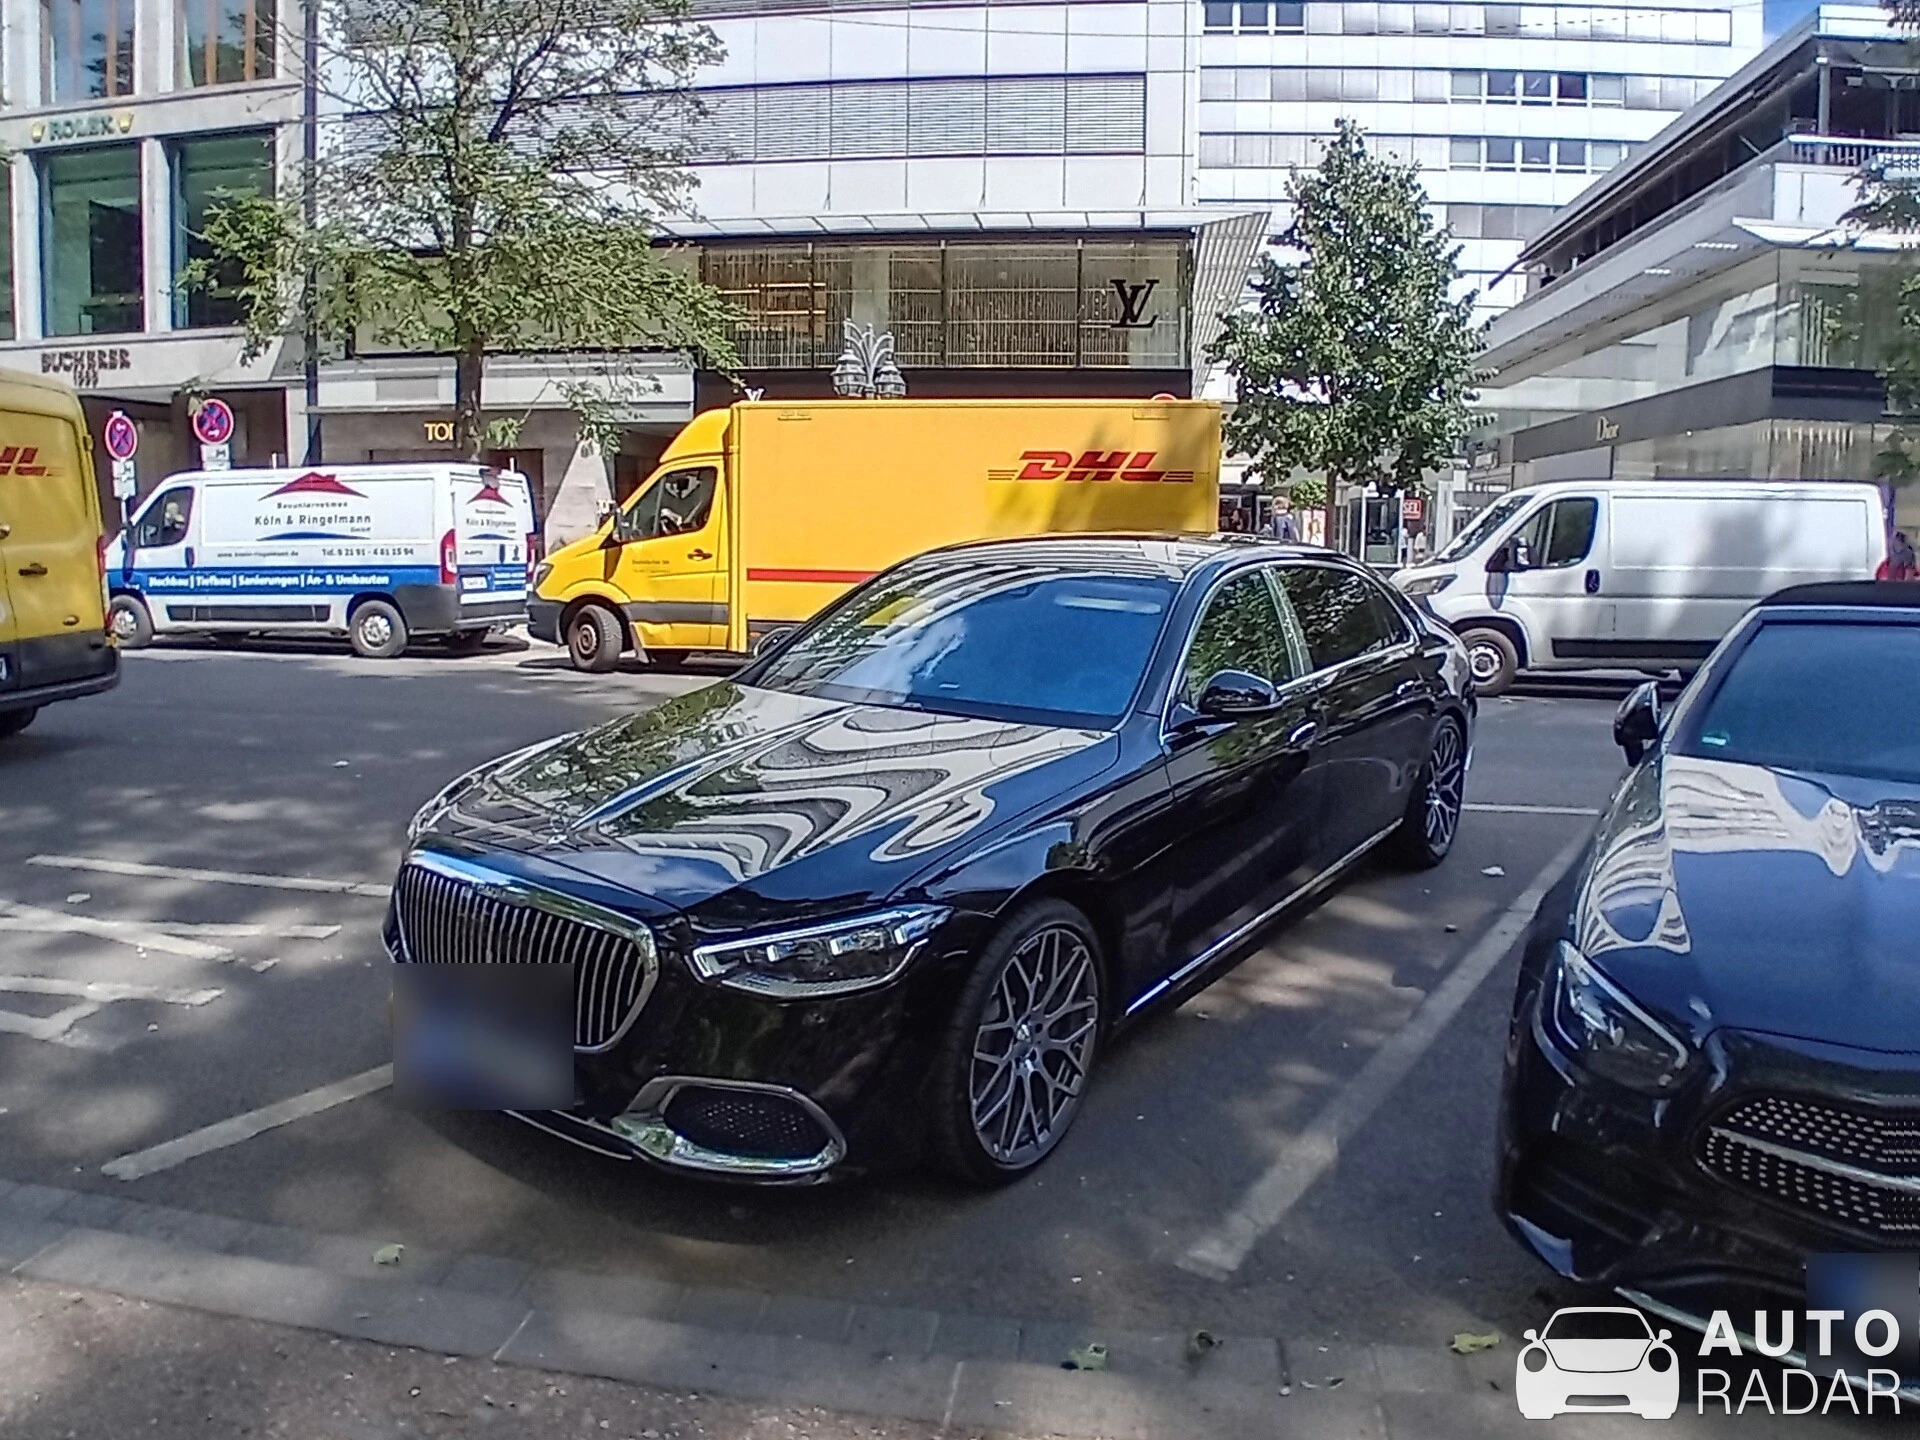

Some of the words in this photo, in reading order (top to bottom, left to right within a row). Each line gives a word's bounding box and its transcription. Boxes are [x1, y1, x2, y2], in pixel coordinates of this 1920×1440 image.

[48, 114, 115, 142] ROLEX
[41, 348, 131, 373] BUCHERER
[1596, 415, 1620, 441] Dior
[1015, 450, 1166, 482] DHL
[286, 515, 293, 525] &
[299, 514, 371, 526] Ringelmann
[335, 573, 390, 585] Umbauten
